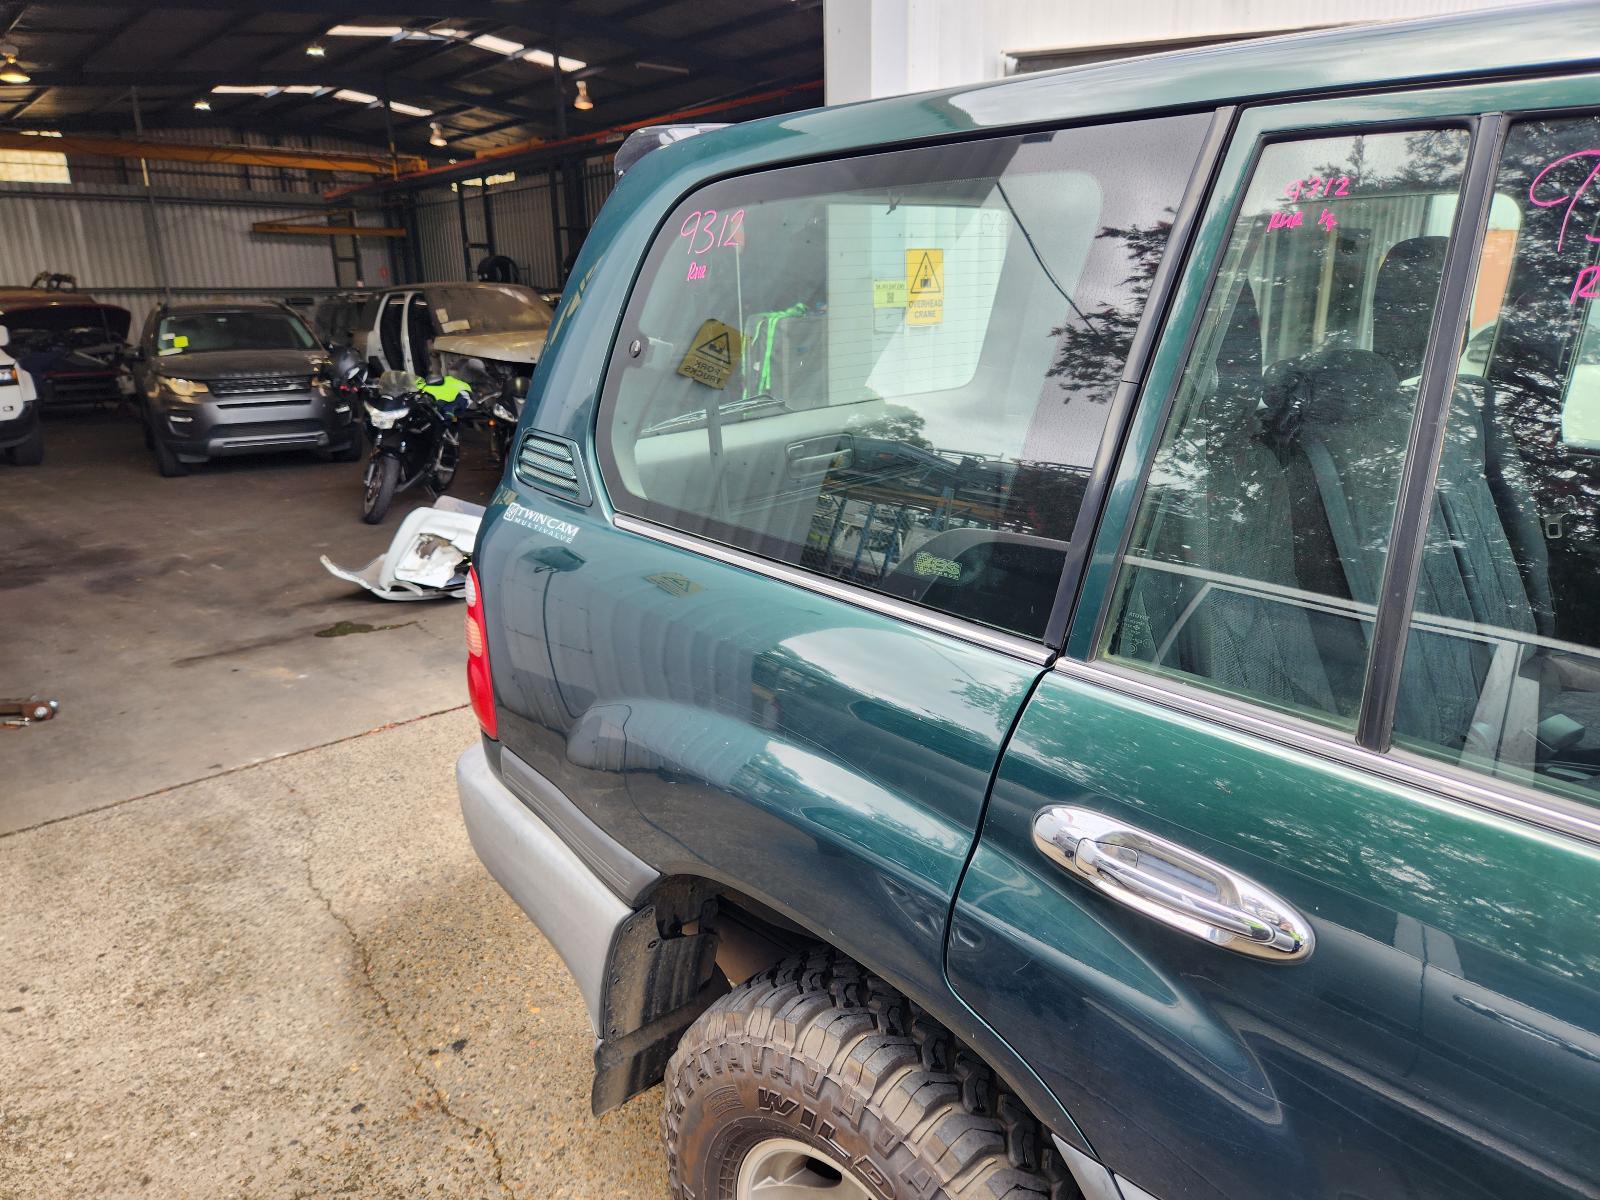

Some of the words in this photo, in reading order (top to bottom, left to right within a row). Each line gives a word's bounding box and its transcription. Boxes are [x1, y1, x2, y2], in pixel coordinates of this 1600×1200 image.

[1282, 176, 1350, 203] 9312
[680, 208, 745, 254] 9312
[908, 299, 944, 308] OVERHEAD
[914, 310, 937, 319] CRANE
[514, 518, 569, 543] MULTIVALVE
[517, 506, 547, 525] TWIN
[547, 518, 580, 537] CAM
[758, 1086, 896, 1200] WILD
